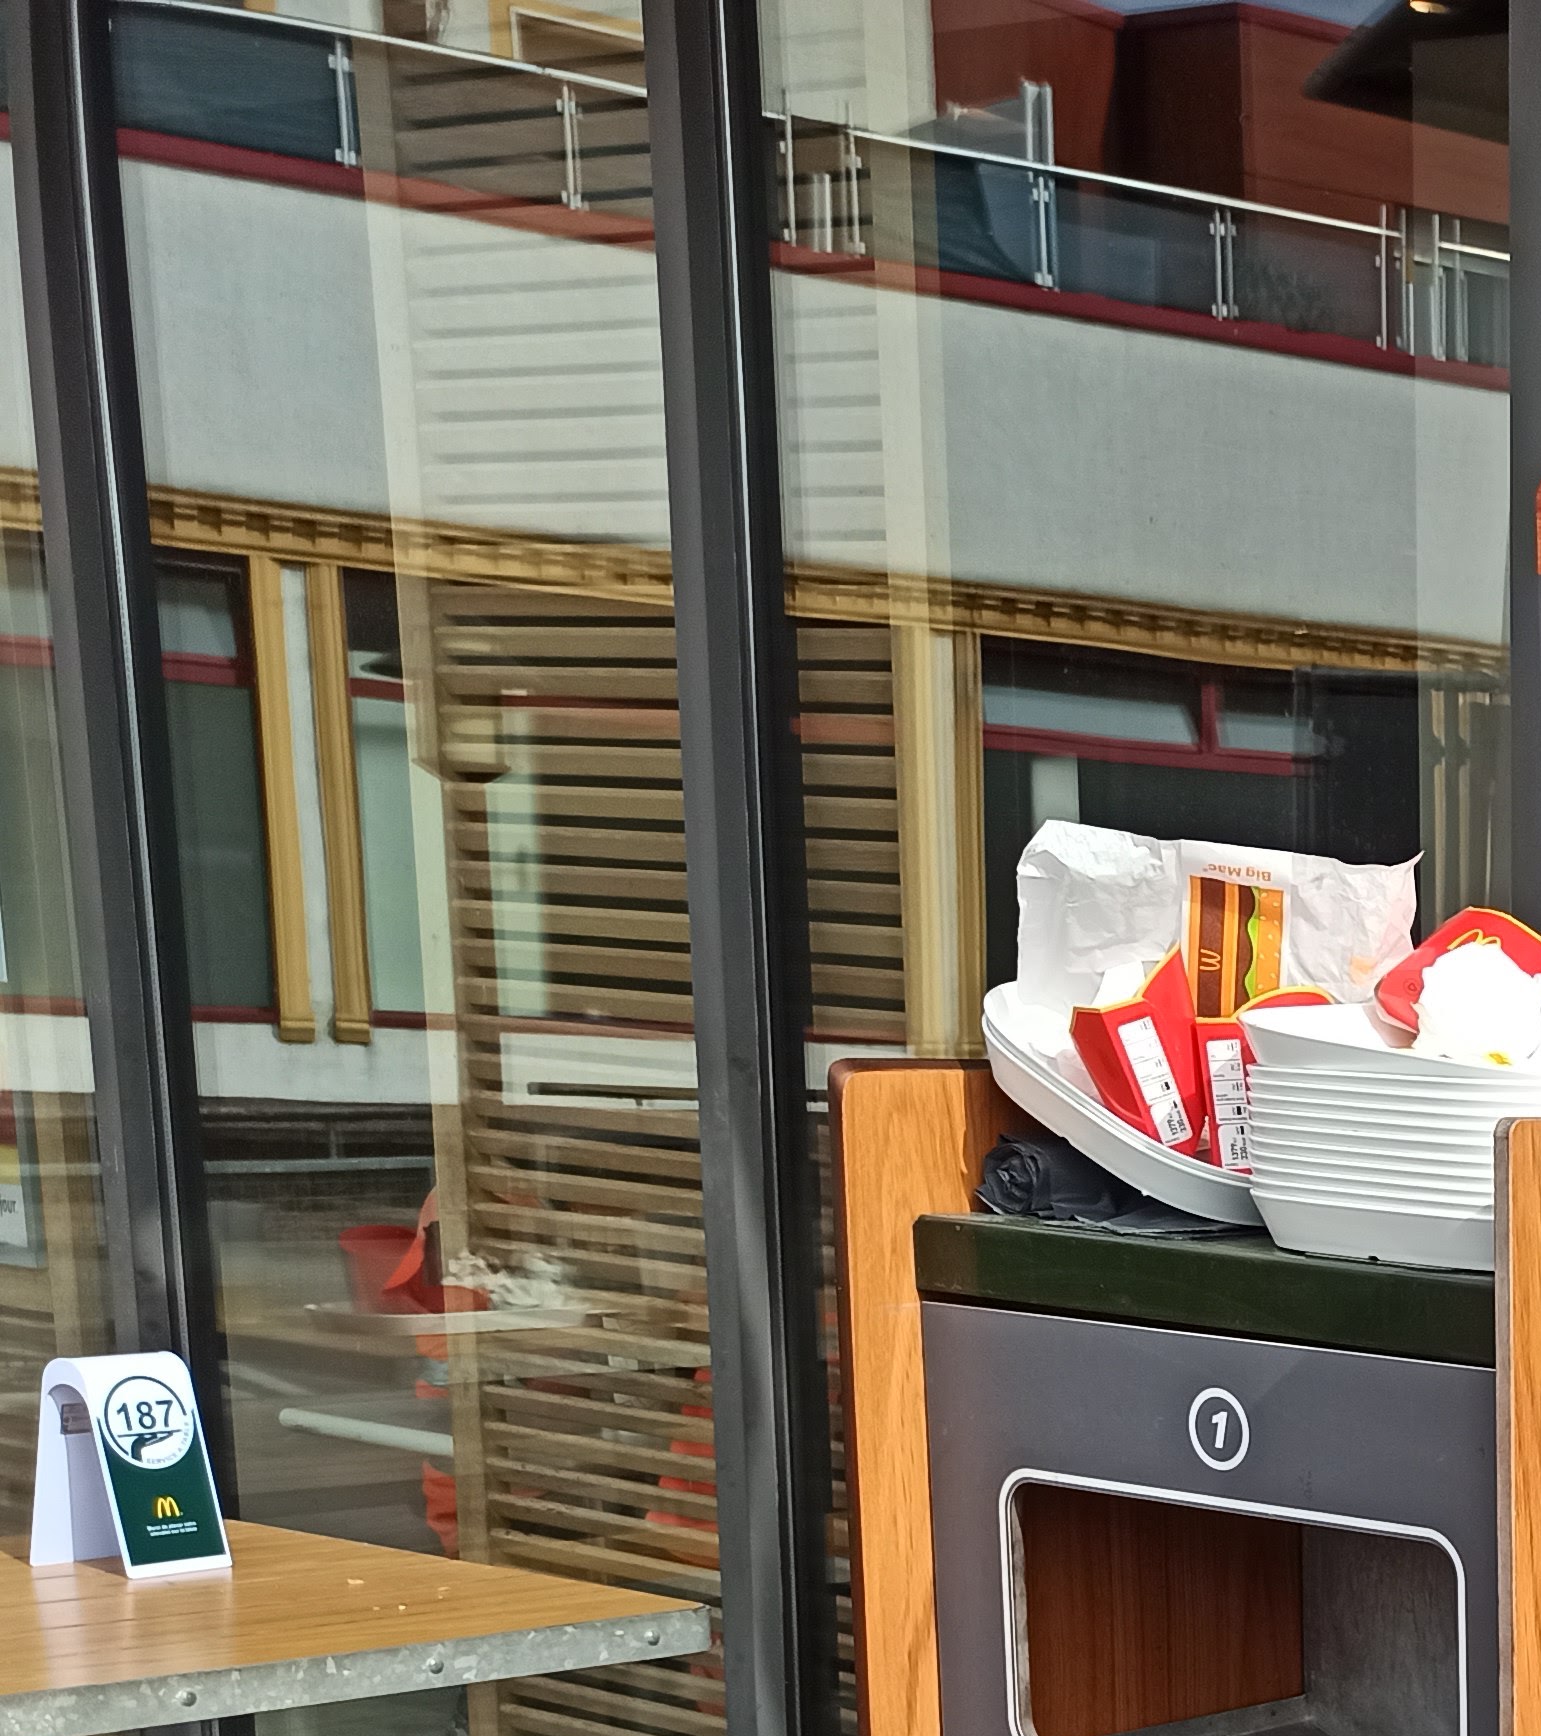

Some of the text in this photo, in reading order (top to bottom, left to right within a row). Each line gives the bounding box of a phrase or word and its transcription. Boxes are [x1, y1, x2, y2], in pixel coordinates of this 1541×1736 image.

[1246, 867, 1272, 882] Big
[116, 1399, 174, 1432] 187
[1211, 1410, 1229, 1450] 1
